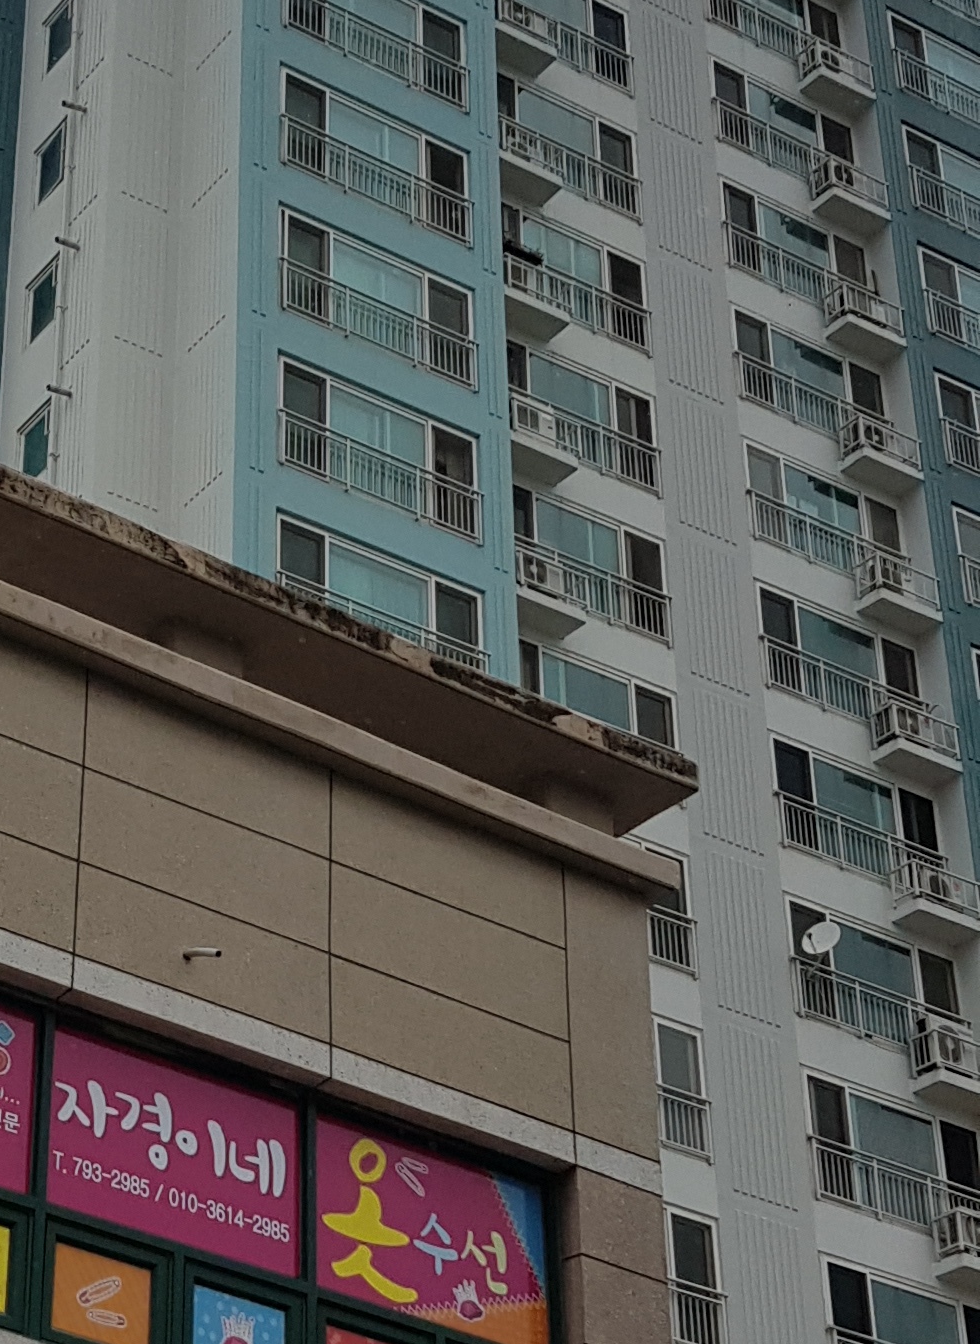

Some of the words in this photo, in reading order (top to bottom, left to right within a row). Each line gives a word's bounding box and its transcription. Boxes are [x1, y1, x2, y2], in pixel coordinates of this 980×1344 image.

[54, 1080, 286, 1198] 자경이네
[53, 1150, 67, 1174] T.
[72, 1156, 150, 1198] 793-2985
[169, 1188, 290, 1243] 010-3614-2985
